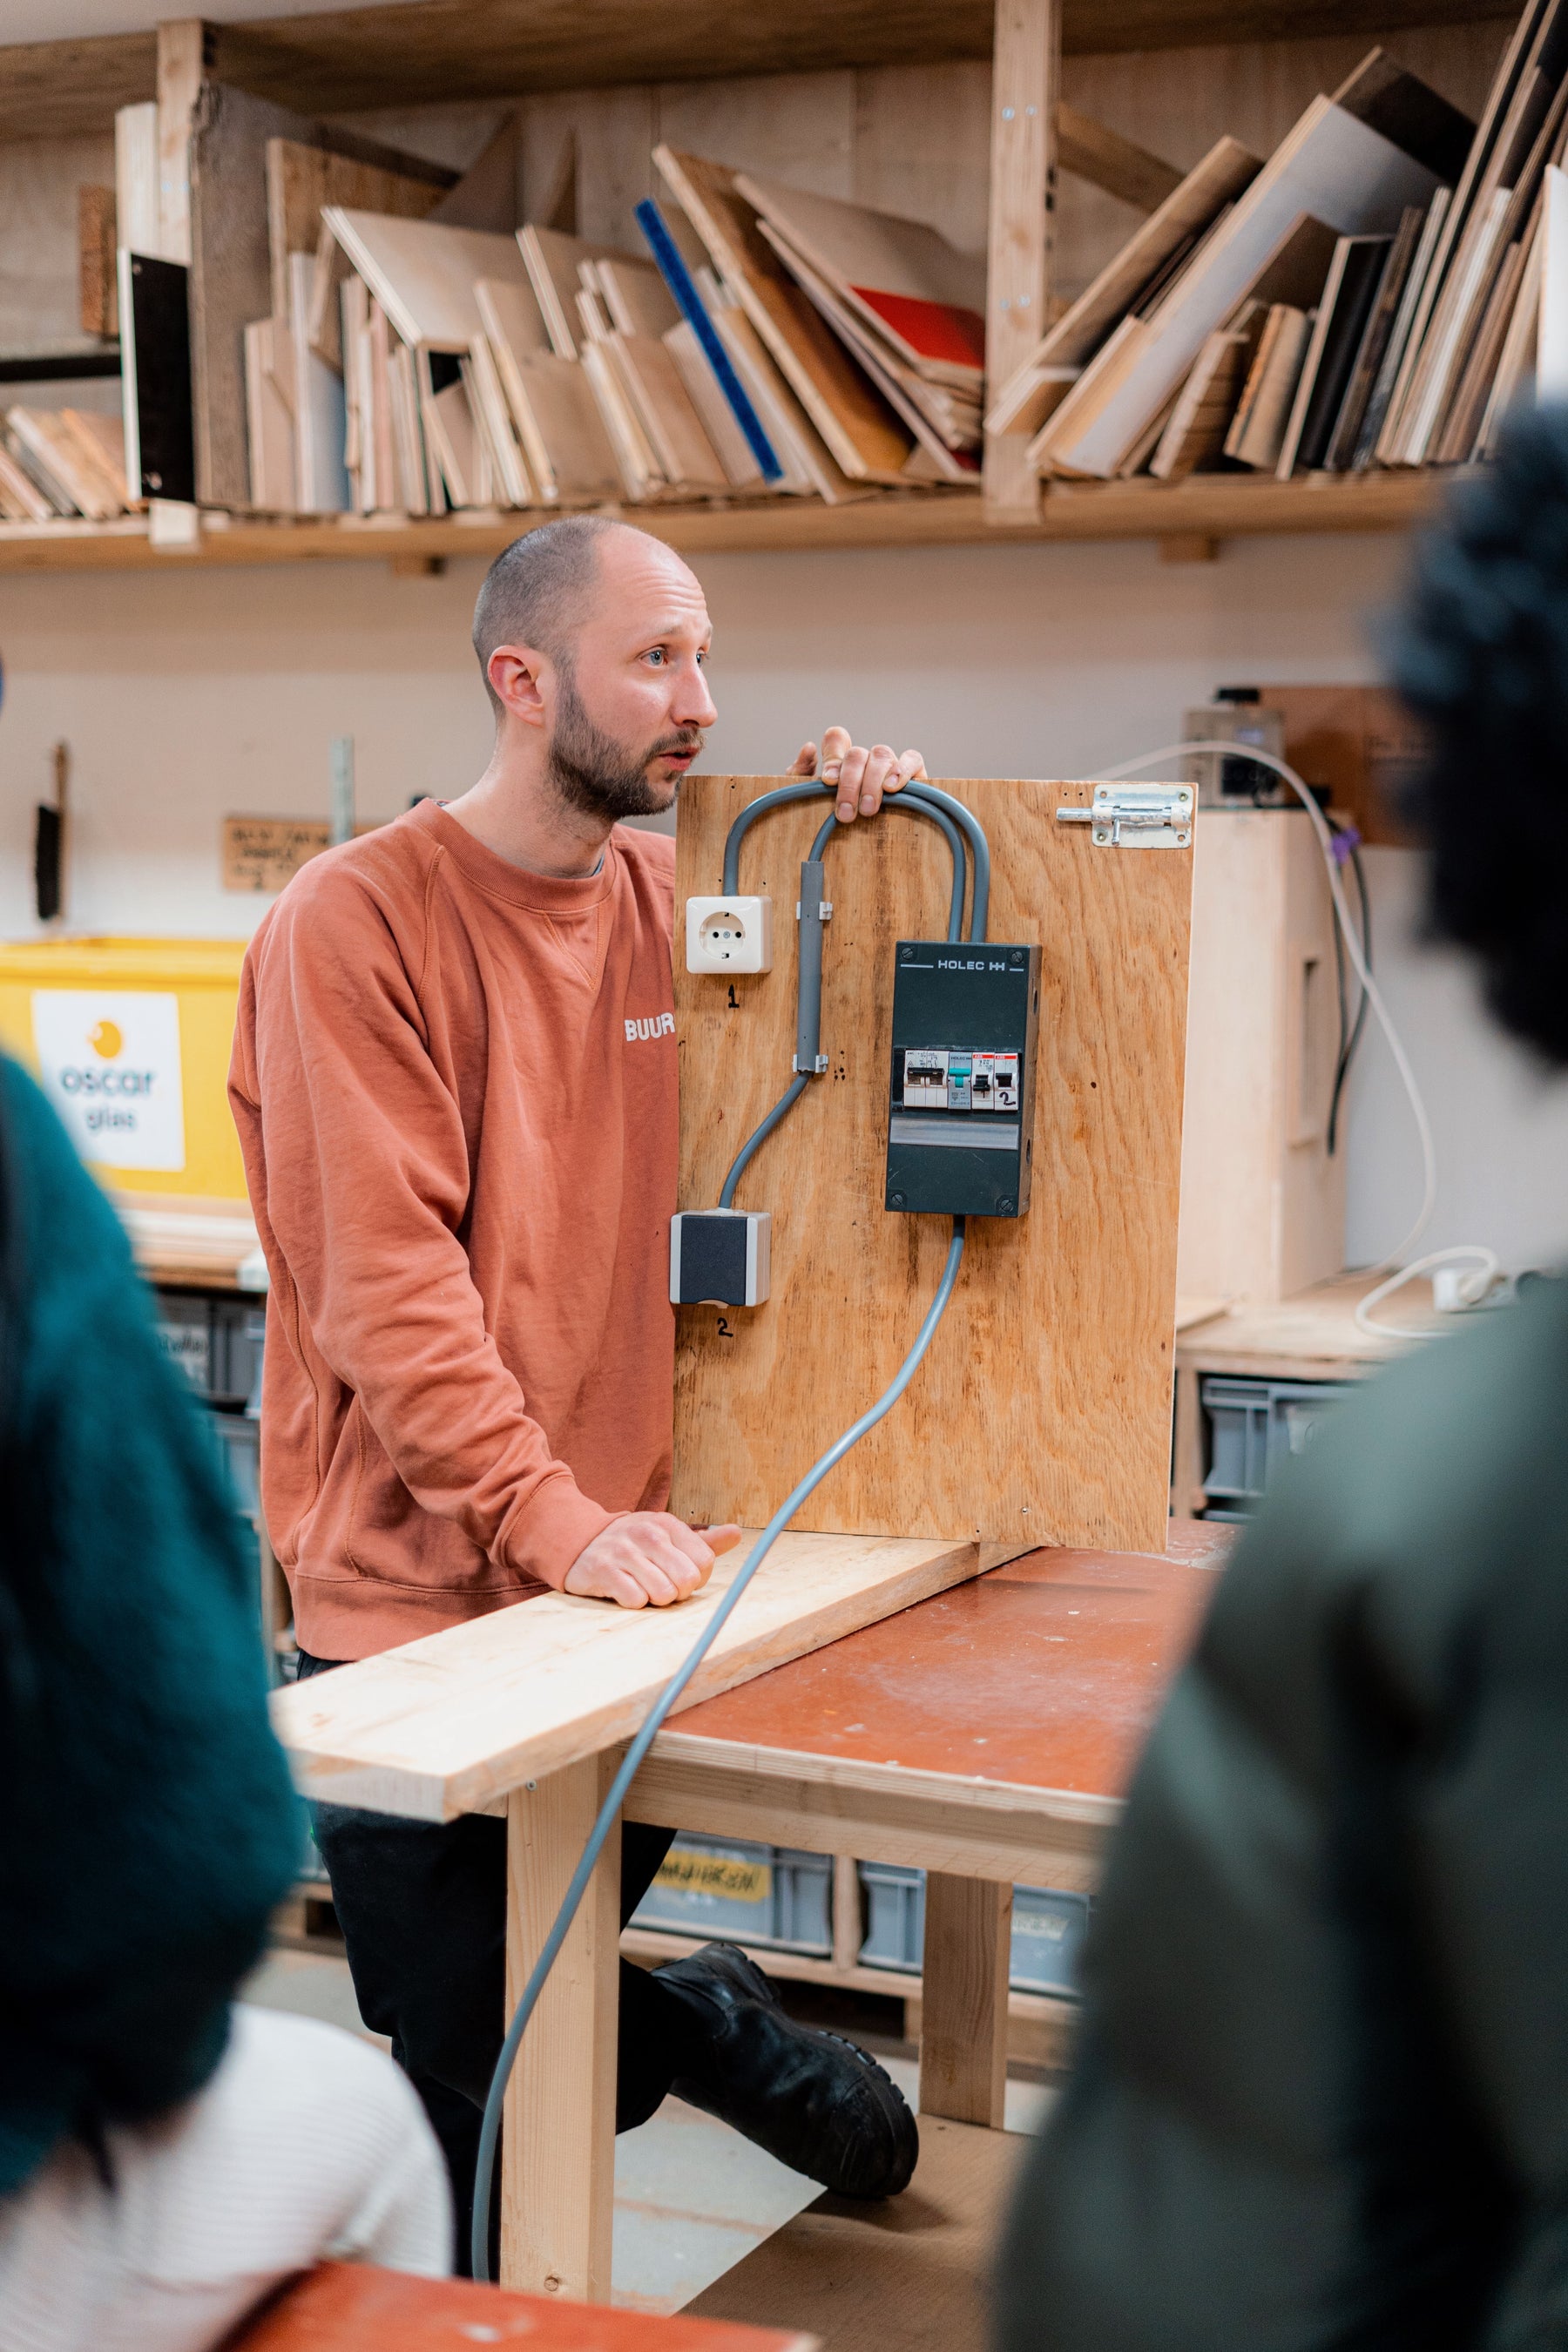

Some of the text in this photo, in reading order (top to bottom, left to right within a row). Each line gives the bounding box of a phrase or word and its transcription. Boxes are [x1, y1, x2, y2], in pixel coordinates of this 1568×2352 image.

[938, 960, 984, 970] HOLEC
[728, 984, 740, 1008] 1
[625, 1012, 676, 1042] BUUR
[61, 1068, 151, 1096] oscar
[998, 1092, 1017, 1105] 2
[717, 1317, 733, 1337] 2
